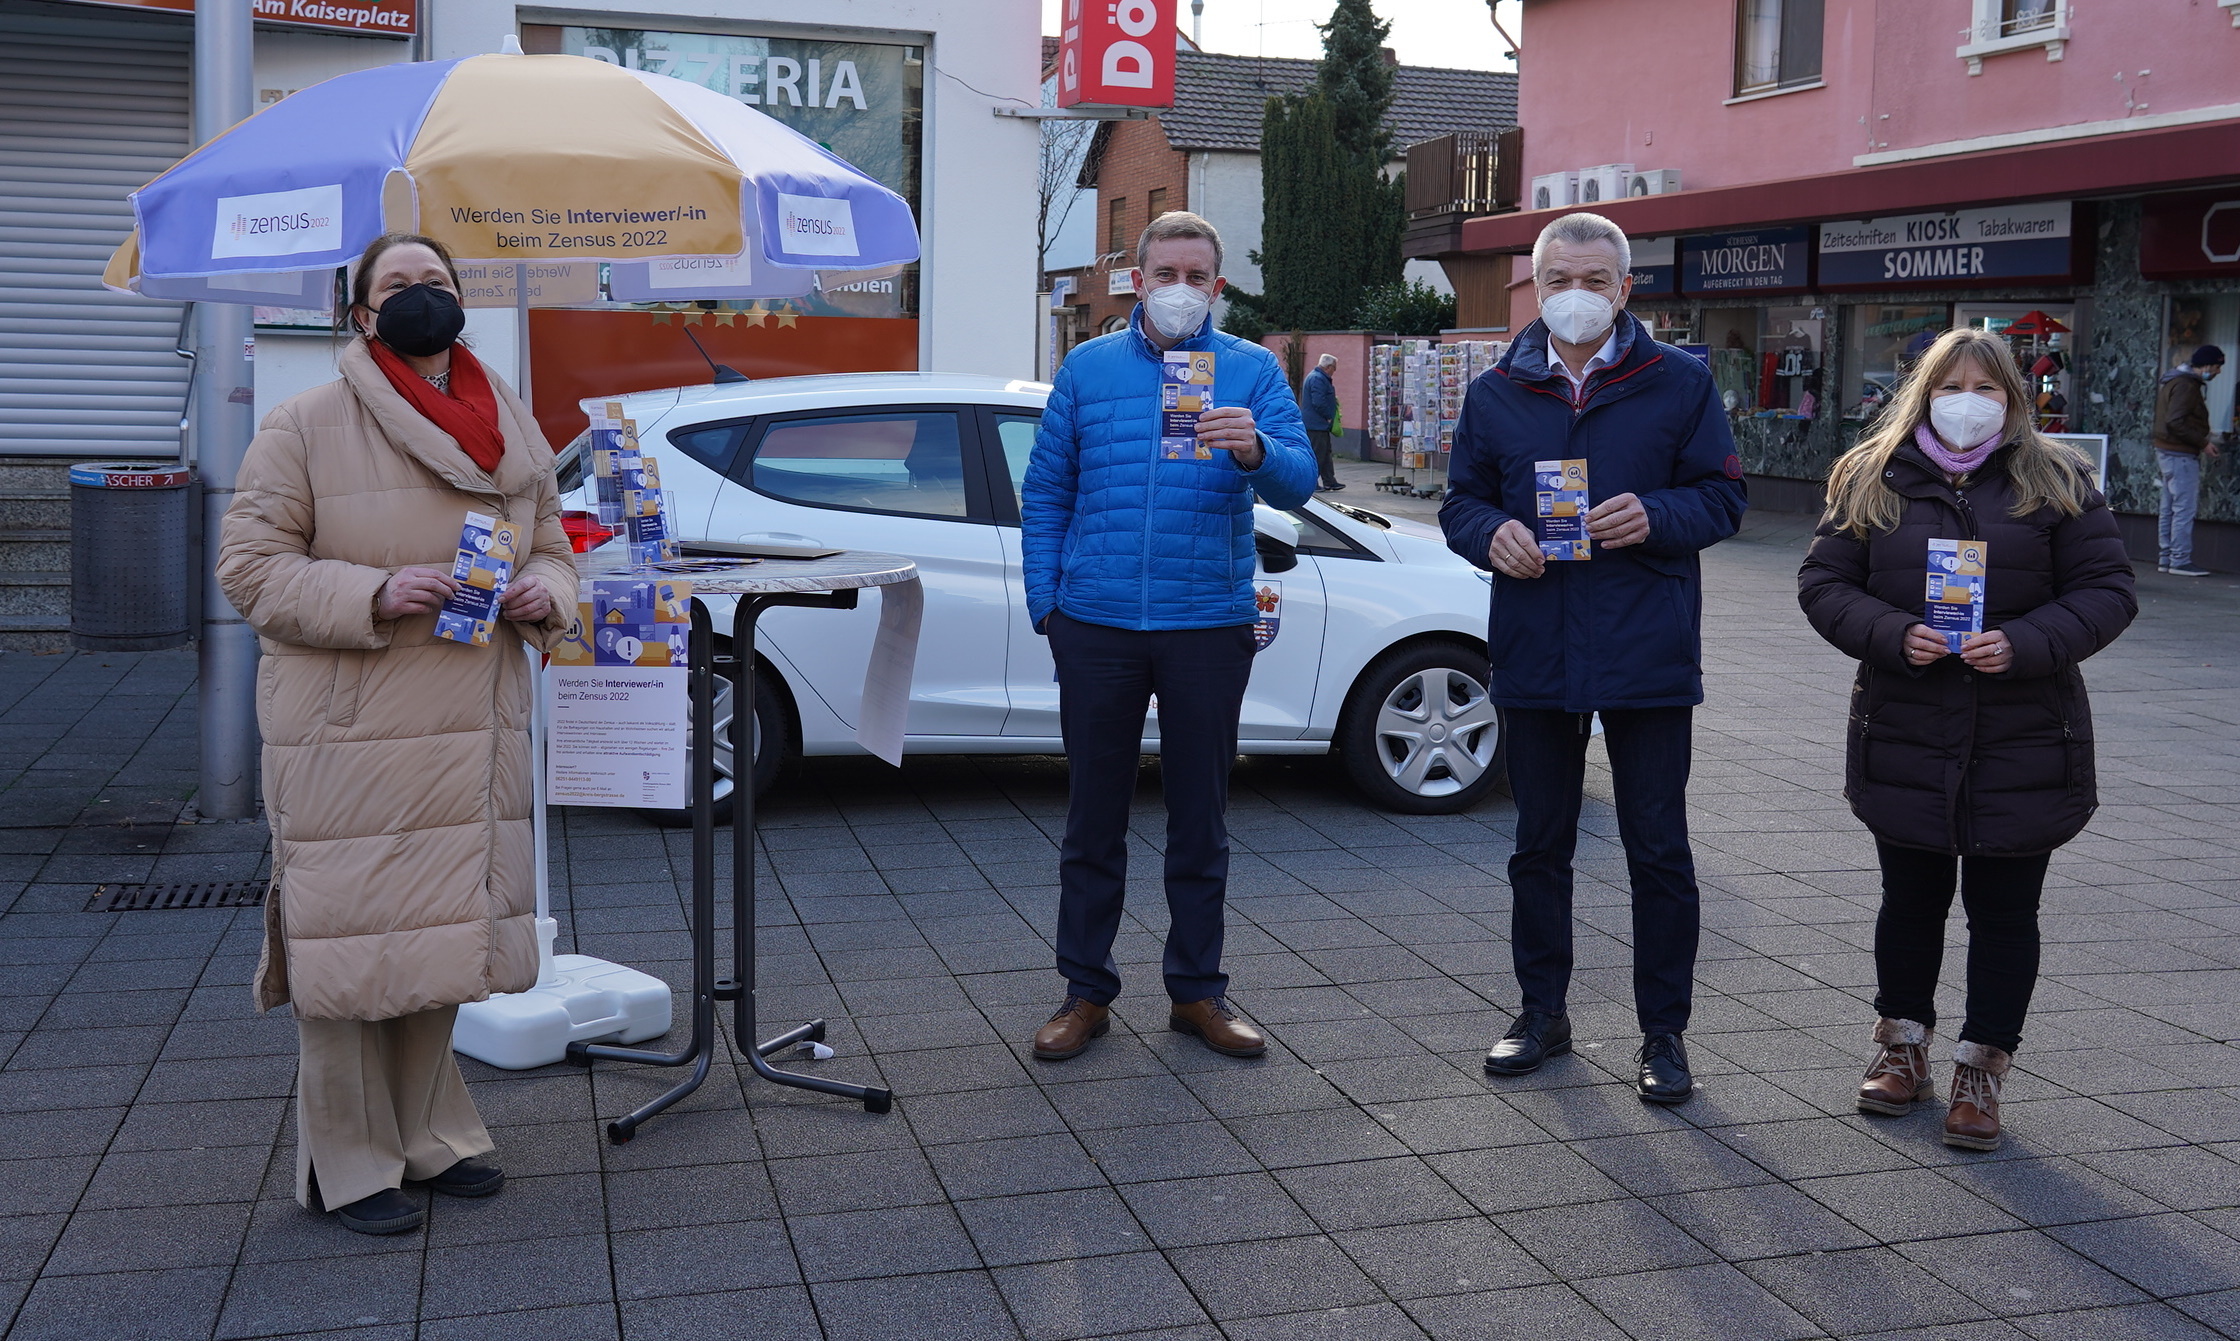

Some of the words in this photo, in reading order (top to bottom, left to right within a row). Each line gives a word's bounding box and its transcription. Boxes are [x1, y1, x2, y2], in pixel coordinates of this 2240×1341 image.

[252, 0, 285, 15] Am
[290, 0, 411, 27] Kaiserplatz
[450, 207, 525, 224] Werden
[531, 208, 561, 224] Sie
[567, 206, 707, 225] Interviewer/-in
[496, 232, 542, 248] beim
[548, 232, 616, 248] Zensus
[622, 230, 668, 247] 2022
[1726, 235, 1759, 246] SÜDHESSEN
[1823, 229, 1896, 248] Zeitschriften
[1906, 218, 1960, 242] KIOSK
[1977, 218, 2054, 237] Tabakwaren
[1700, 243, 1787, 275] MORGEN
[1884, 247, 1984, 279] SOMMER
[1703, 277, 1744, 289] AUFGEWECKT
[1745, 277, 1753, 286] IN
[1754, 276, 1768, 286] DEN
[1770, 275, 1783, 285] TAG
[558, 679, 589, 688] Werden
[591, 679, 603, 688] Sie
[605, 679, 664, 689] Interviewer/-in
[558, 691, 577, 700] beim
[579, 692, 608, 701] Zensus
[609, 692, 629, 701] 2022
